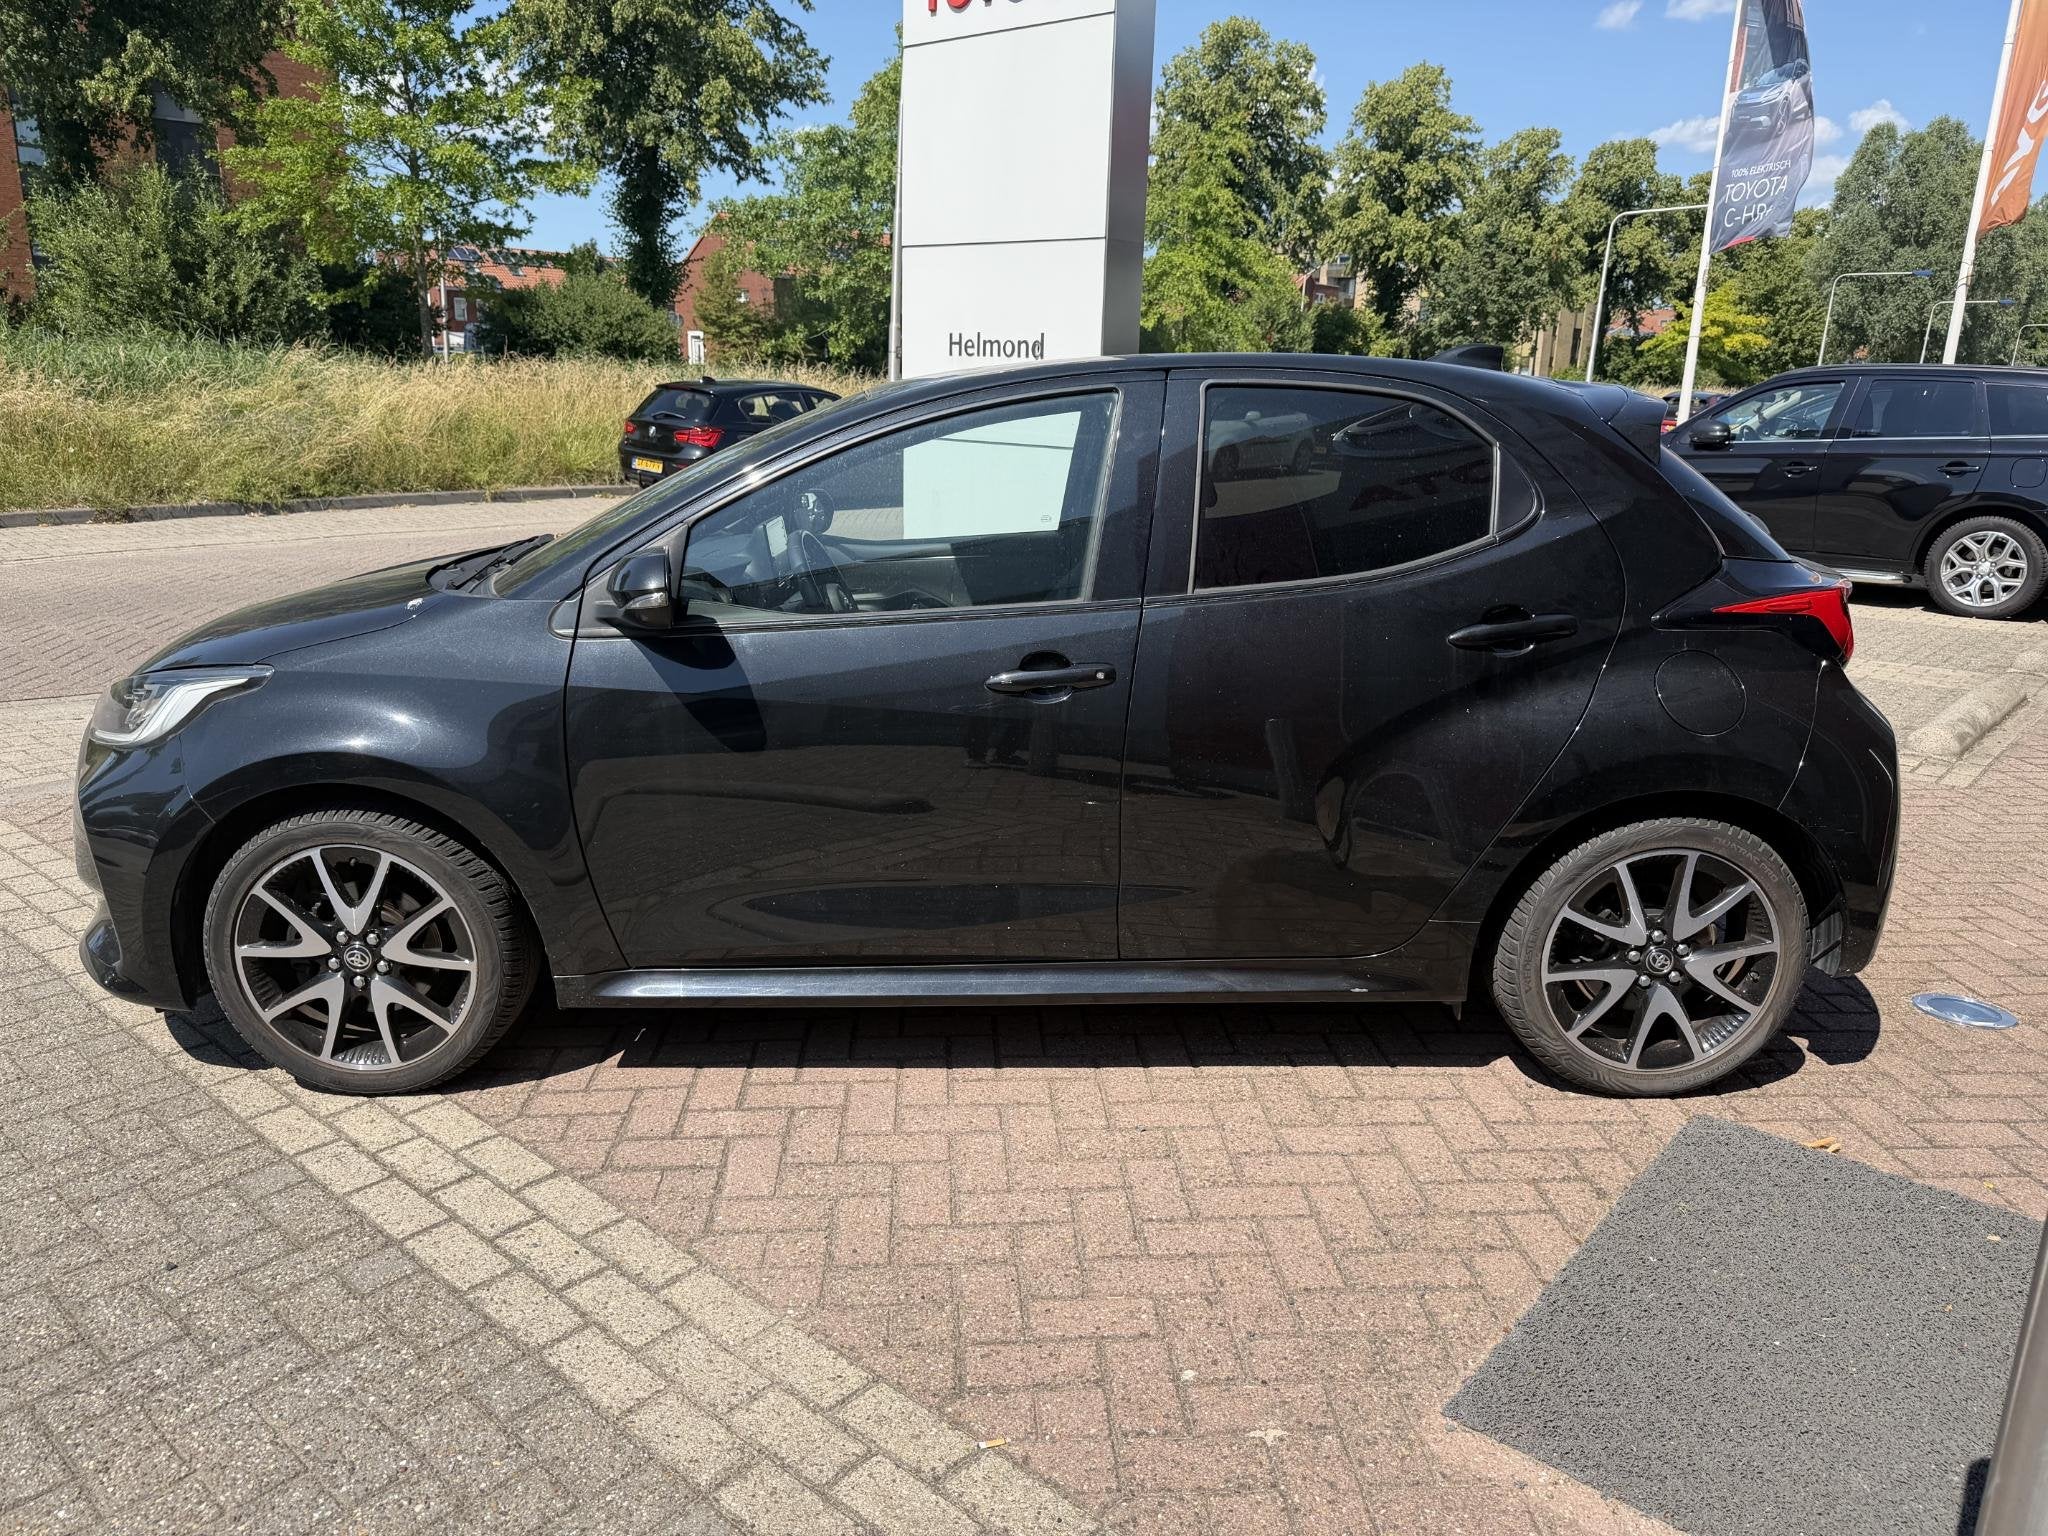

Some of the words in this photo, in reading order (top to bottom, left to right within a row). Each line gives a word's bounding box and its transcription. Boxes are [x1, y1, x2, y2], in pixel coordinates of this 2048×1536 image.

[1731, 168, 1749, 178] 100%
[1725, 175, 1788, 204] TOYOTA
[949, 331, 1045, 360] Helmond
